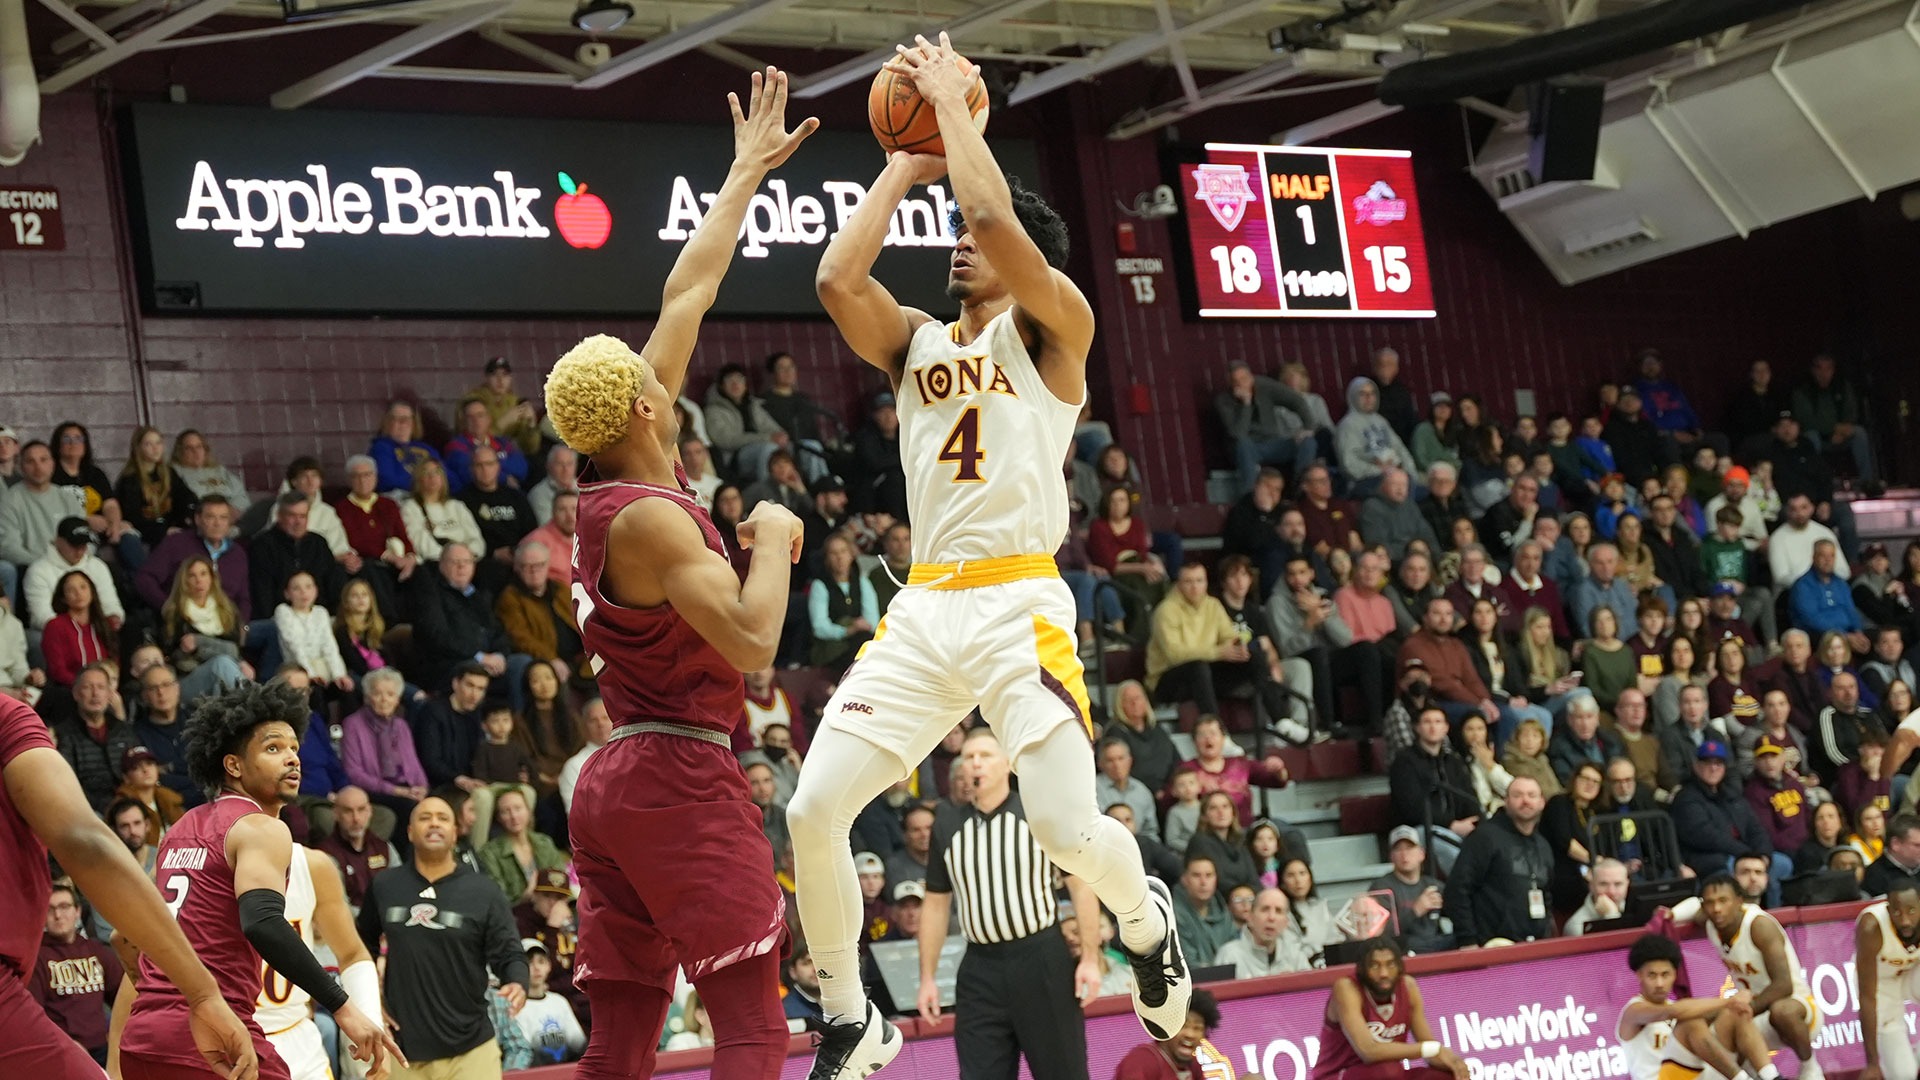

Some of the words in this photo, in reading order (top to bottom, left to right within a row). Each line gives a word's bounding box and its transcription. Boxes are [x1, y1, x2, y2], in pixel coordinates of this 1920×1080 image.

[176, 160, 373, 248] Apple
[371, 166, 550, 238] Bank
[1270, 173, 1331, 200] HALF
[9, 211, 45, 245] 12
[658, 175, 826, 258] Aple
[1295, 204, 1317, 245] 1
[1115, 257, 1164, 274] SECTION
[1209, 244, 1262, 294] 18
[1363, 245, 1412, 293] 15
[1130, 275, 1156, 304] 13
[913, 354, 1020, 407] IONA
[937, 405, 988, 484] 4
[841, 701, 874, 715] MAAC
[47, 955, 105, 989] IONA
